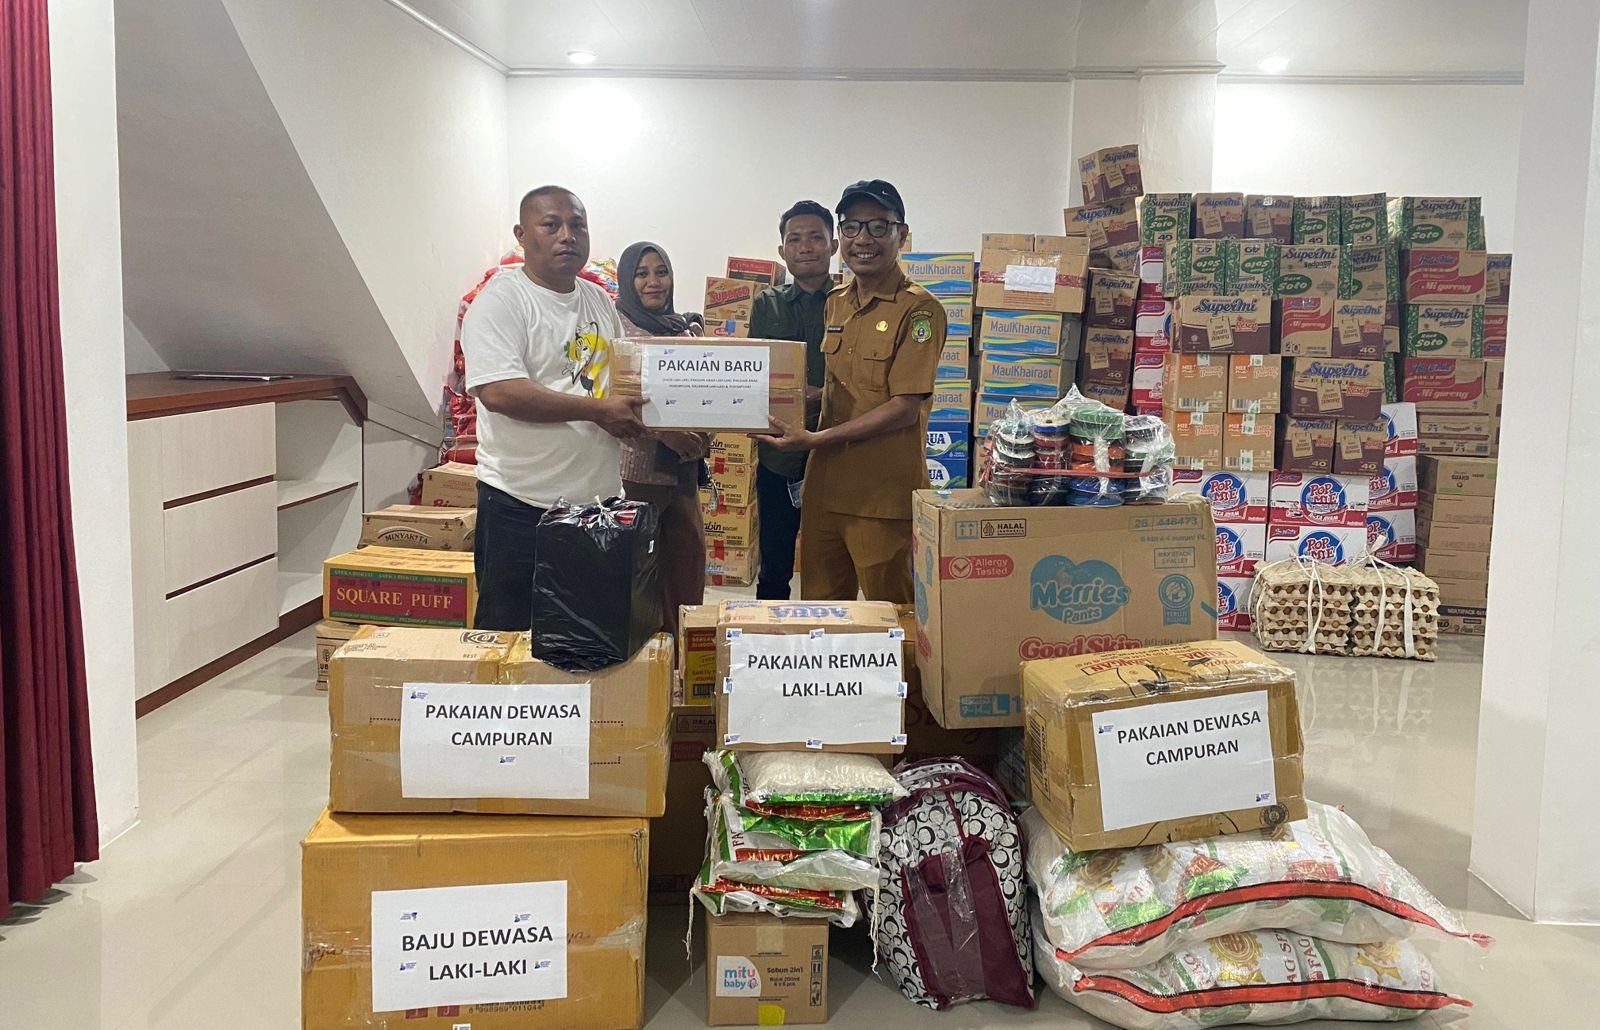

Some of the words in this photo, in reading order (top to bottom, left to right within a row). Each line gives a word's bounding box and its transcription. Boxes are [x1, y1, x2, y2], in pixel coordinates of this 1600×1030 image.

[1150, 220, 1173, 228] Soto
[1299, 222, 1325, 231] Soto
[1347, 221, 1372, 231] Soto
[1307, 236, 1324, 244] 40
[1410, 230, 1439, 241] Soto
[907, 262, 966, 276] MaulKhairaat
[1276, 281, 1308, 291] Soto
[1437, 282, 1472, 293] goreng
[990, 320, 1052, 336] MaulKhairaat
[1415, 338, 1444, 348] Soto
[658, 359, 720, 372] PAKAIAN
[724, 360, 763, 372] BARU
[991, 364, 1053, 379] MaulKhairaat
[1435, 390, 1469, 400] goreng
[1214, 488, 1239, 501] MIE
[1311, 547, 1335, 561] MIE
[975, 558, 1008, 568] Allergy
[975, 567, 1008, 577] Tested
[336, 586, 403, 606] SQUARE
[411, 593, 453, 609] PUFF
[1029, 577, 1131, 611] Merries
[769, 606, 850, 618] AQUA
[1062, 607, 1103, 624] Pants
[1019, 634, 1087, 661] Good
[1087, 633, 1143, 655] Skin
[748, 654, 823, 670] PAKAIAN
[828, 652, 898, 669] REMAJA
[782, 681, 863, 697] LAKI-LAKI
[425, 704, 502, 719] PAKAIAN
[507, 704, 581, 719] DEWASA
[1117, 720, 1189, 744] PAKAIAN
[1193, 710, 1262, 734] DEWASA
[451, 731, 553, 747] CAMPURAN
[1146, 739, 1240, 766] CAMPURAN
[402, 931, 455, 952] BAJU
[462, 925, 554, 948] DEWASA
[429, 959, 527, 982] LAKI-LAKI
[724, 966, 756, 979] mitu
[723, 978, 747, 990] baby
